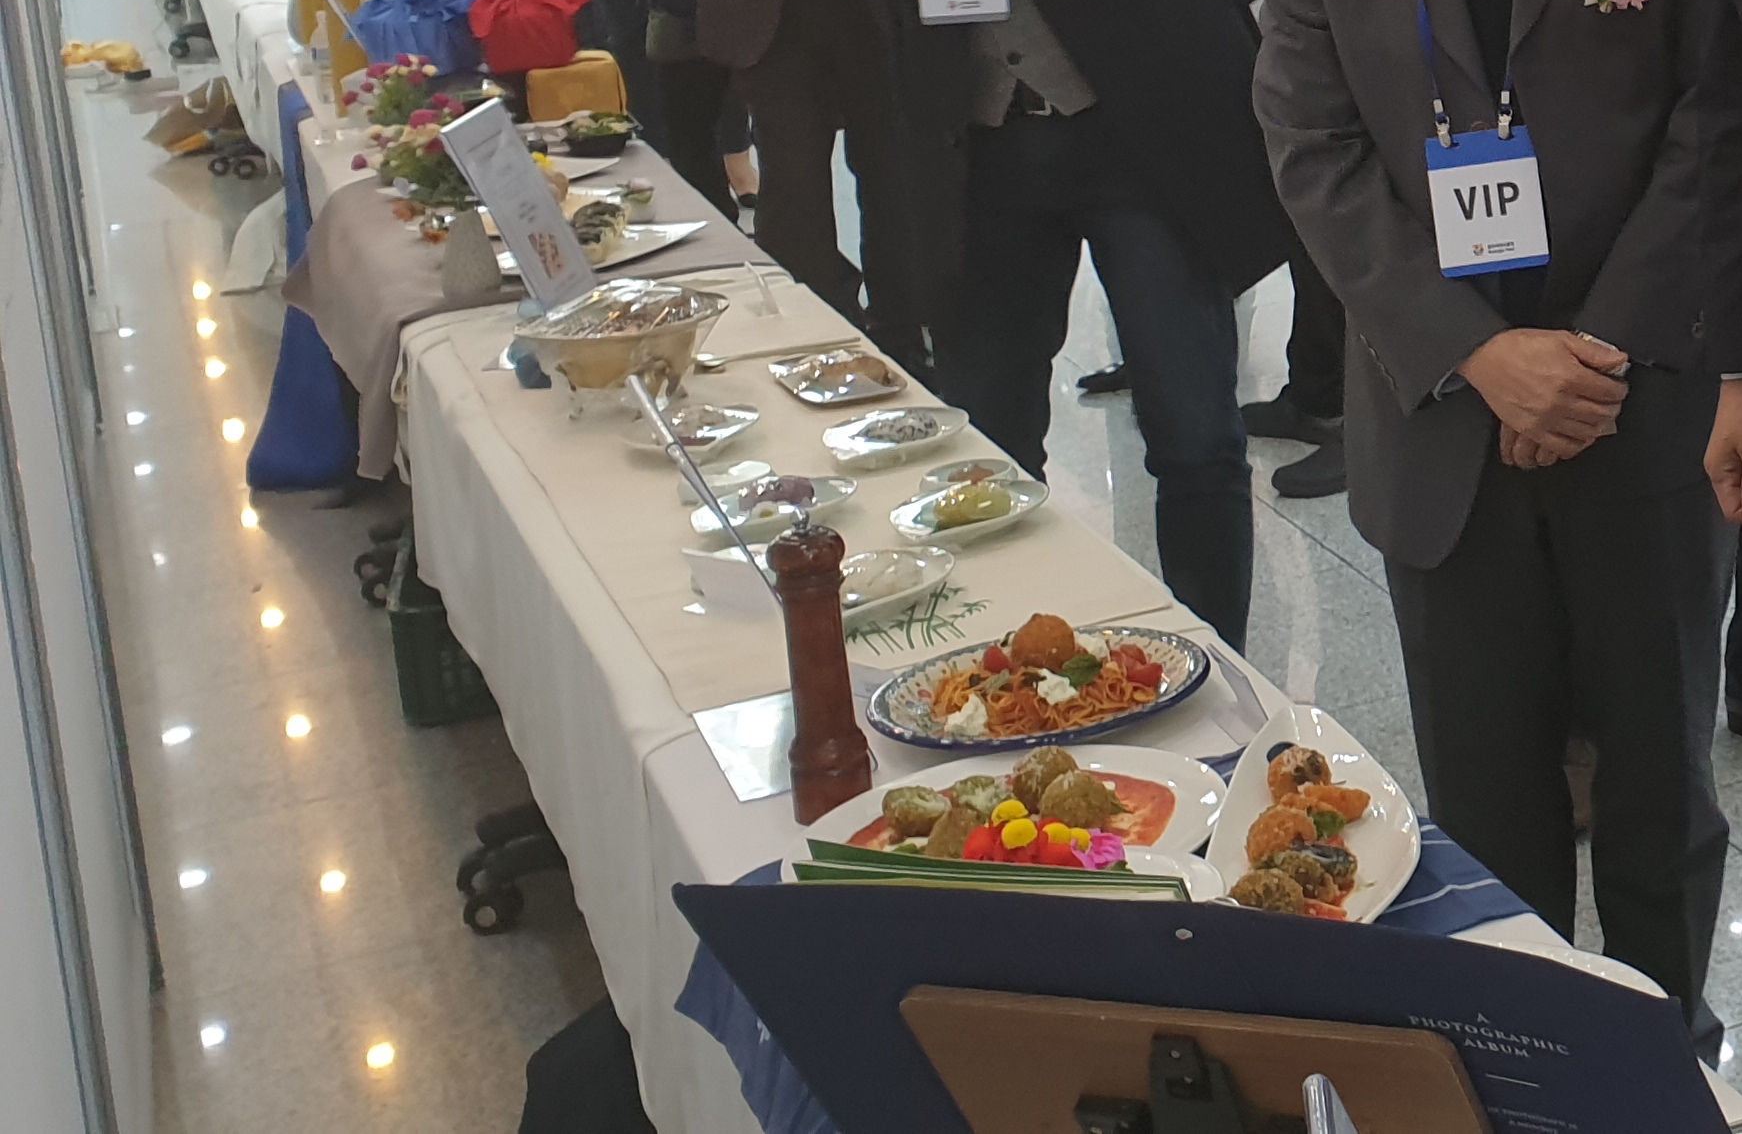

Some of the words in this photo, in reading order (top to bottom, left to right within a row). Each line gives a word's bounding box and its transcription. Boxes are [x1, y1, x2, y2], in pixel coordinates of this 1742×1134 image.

[1453, 181, 1520, 221] VIP
[1476, 1012, 1490, 1024] A
[1408, 1015, 1570, 1056] PHOTOGRAPHIC
[1464, 1038, 1530, 1058] ALBUM
